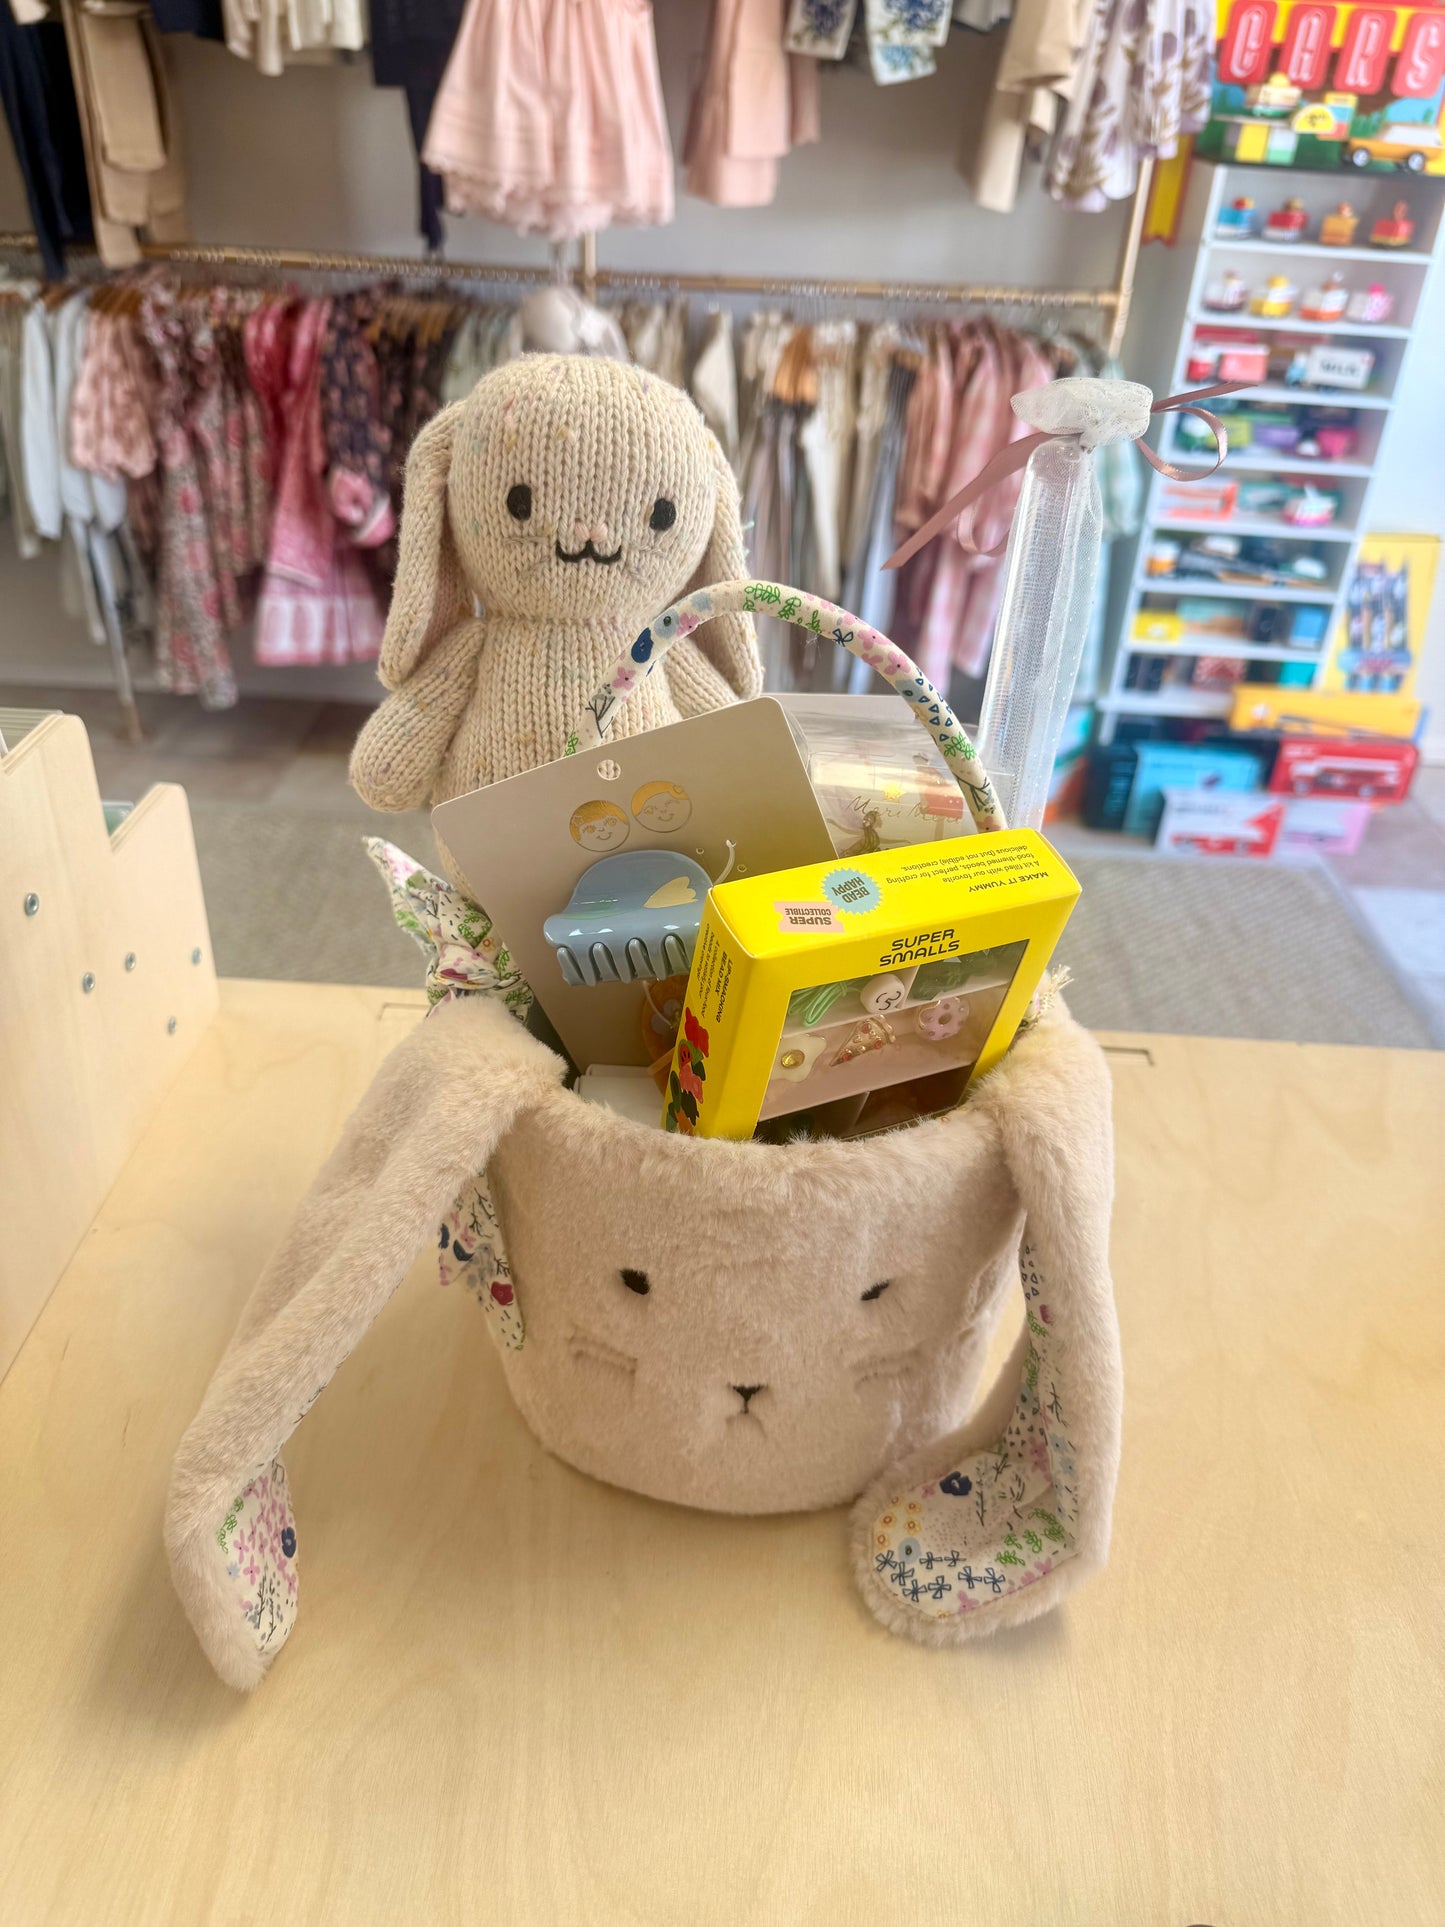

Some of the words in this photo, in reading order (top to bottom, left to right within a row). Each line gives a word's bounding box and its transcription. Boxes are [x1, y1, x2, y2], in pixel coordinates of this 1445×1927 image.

[1230, 4, 1445, 91] CARS
[979, 849, 996, 858] (but
[995, 845, 1027, 854] delicious
[939, 855, 965, 866] edible)
[986, 852, 1034, 866] food-themed
[901, 860, 938, 871] creations.
[931, 865, 959, 876] perfect
[959, 861, 987, 870] beads,
[986, 867, 1004, 875] with
[1003, 863, 1023, 872] filled
[886, 873, 918, 884] crafting
[942, 873, 972, 883] favorite
[1008, 877, 1018, 885] IT
[1018, 871, 1049, 883] MAKE
[831, 876, 865, 896] HAPPY
[968, 880, 1007, 893] YUMMY
[841, 886, 870, 903] BEAD
[785, 908, 832, 916] COLLECTIBLE
[789, 916, 832, 925] SUPER
[891, 929, 955, 951] SUPER
[879, 940, 960, 967] SMALLS
[718, 951, 727, 979] BEAD
